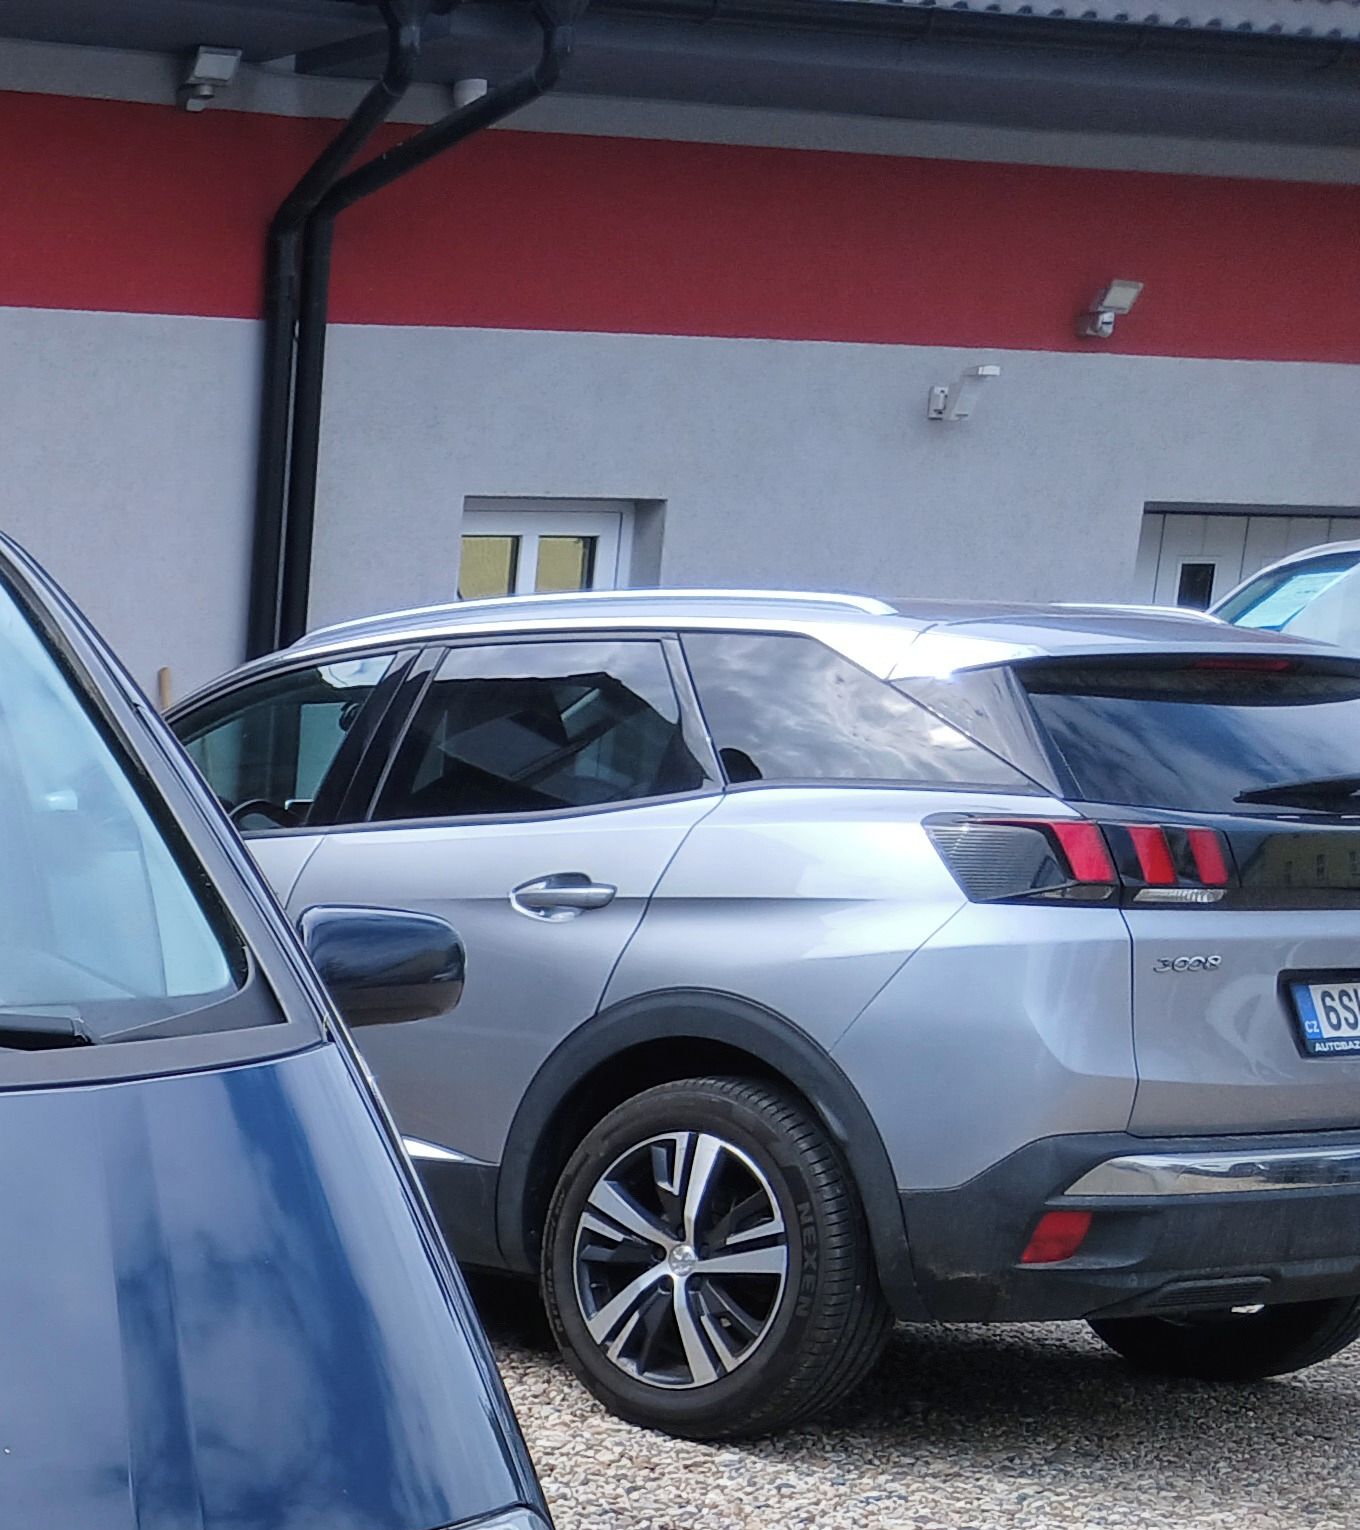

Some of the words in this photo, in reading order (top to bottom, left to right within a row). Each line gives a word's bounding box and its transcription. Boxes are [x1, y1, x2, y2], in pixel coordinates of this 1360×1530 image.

[1153, 955, 1222, 973] 3008
[1304, 1020, 1320, 1033] CZ
[795, 1201, 817, 1317] NEXEN
